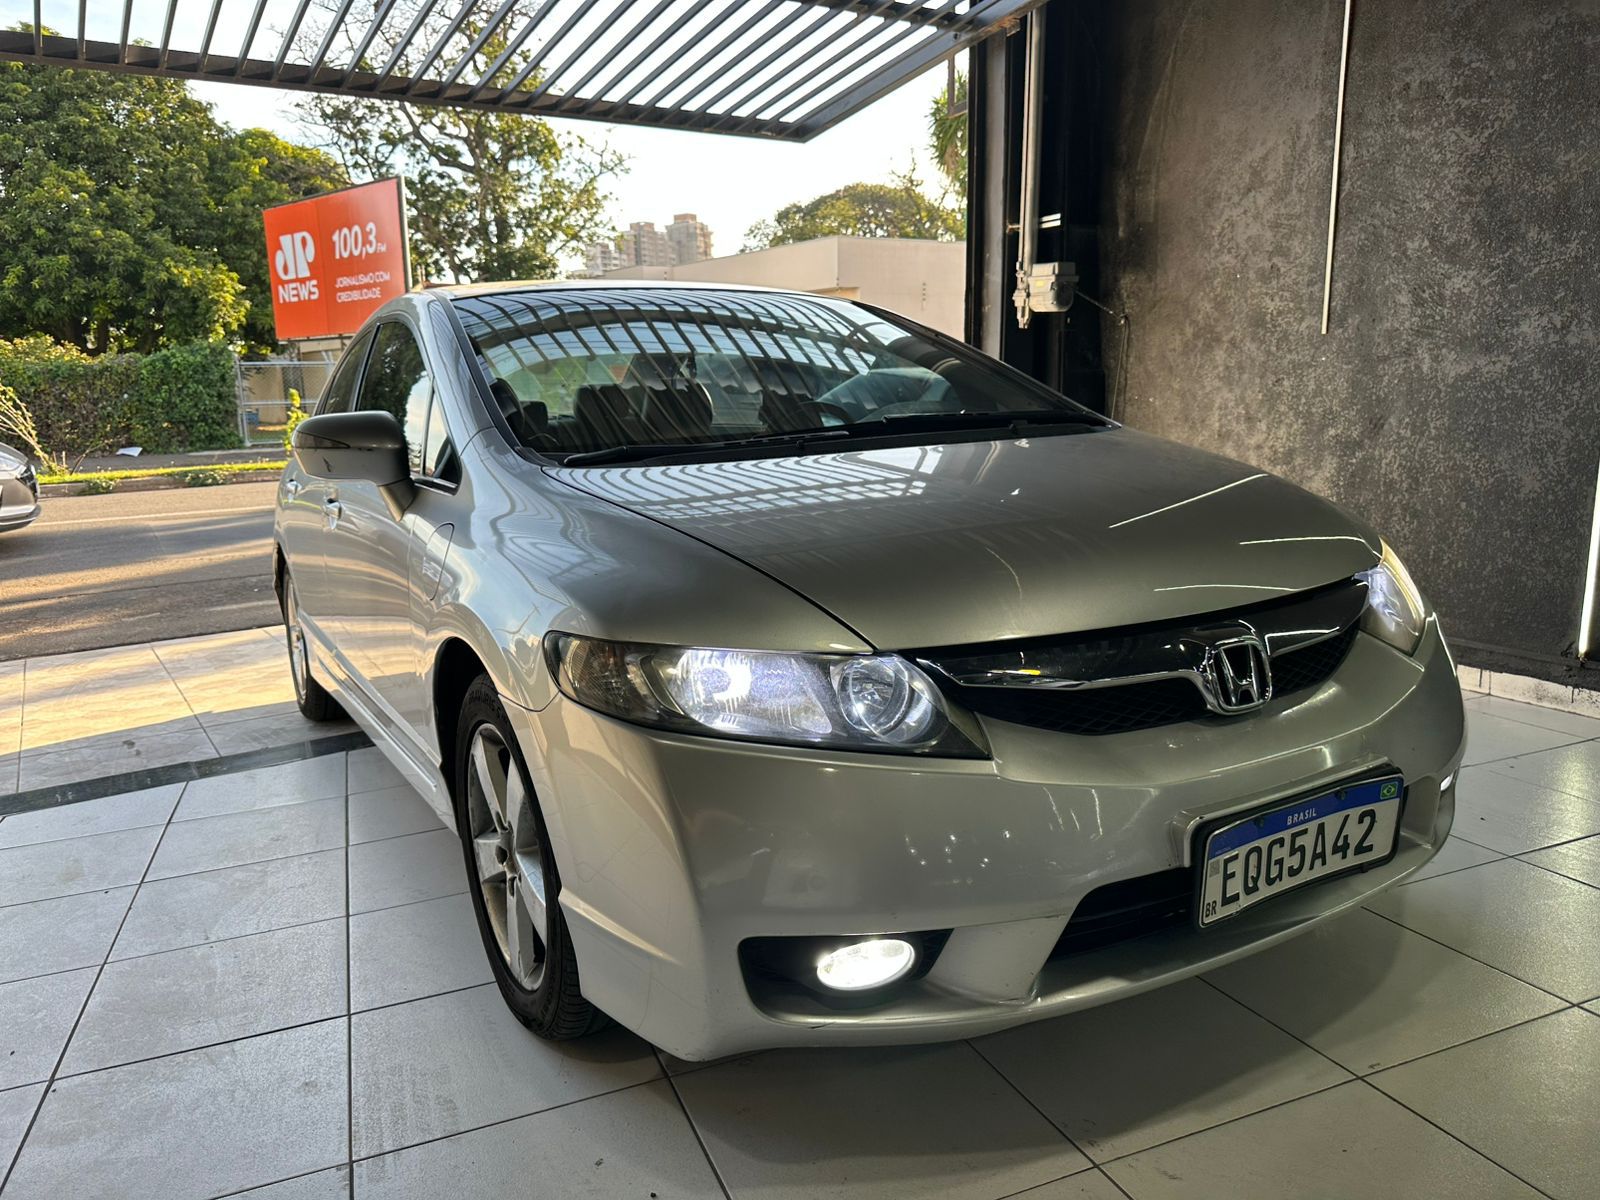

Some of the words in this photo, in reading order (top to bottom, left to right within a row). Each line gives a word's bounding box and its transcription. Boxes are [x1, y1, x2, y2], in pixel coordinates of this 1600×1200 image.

[332, 221, 377, 260] 100,3
[374, 271, 391, 283] COM
[278, 280, 319, 304] NEWS
[1286, 807, 1317, 826] BRASIL
[1220, 808, 1377, 908] EQG5A42
[1205, 900, 1218, 918] BR
